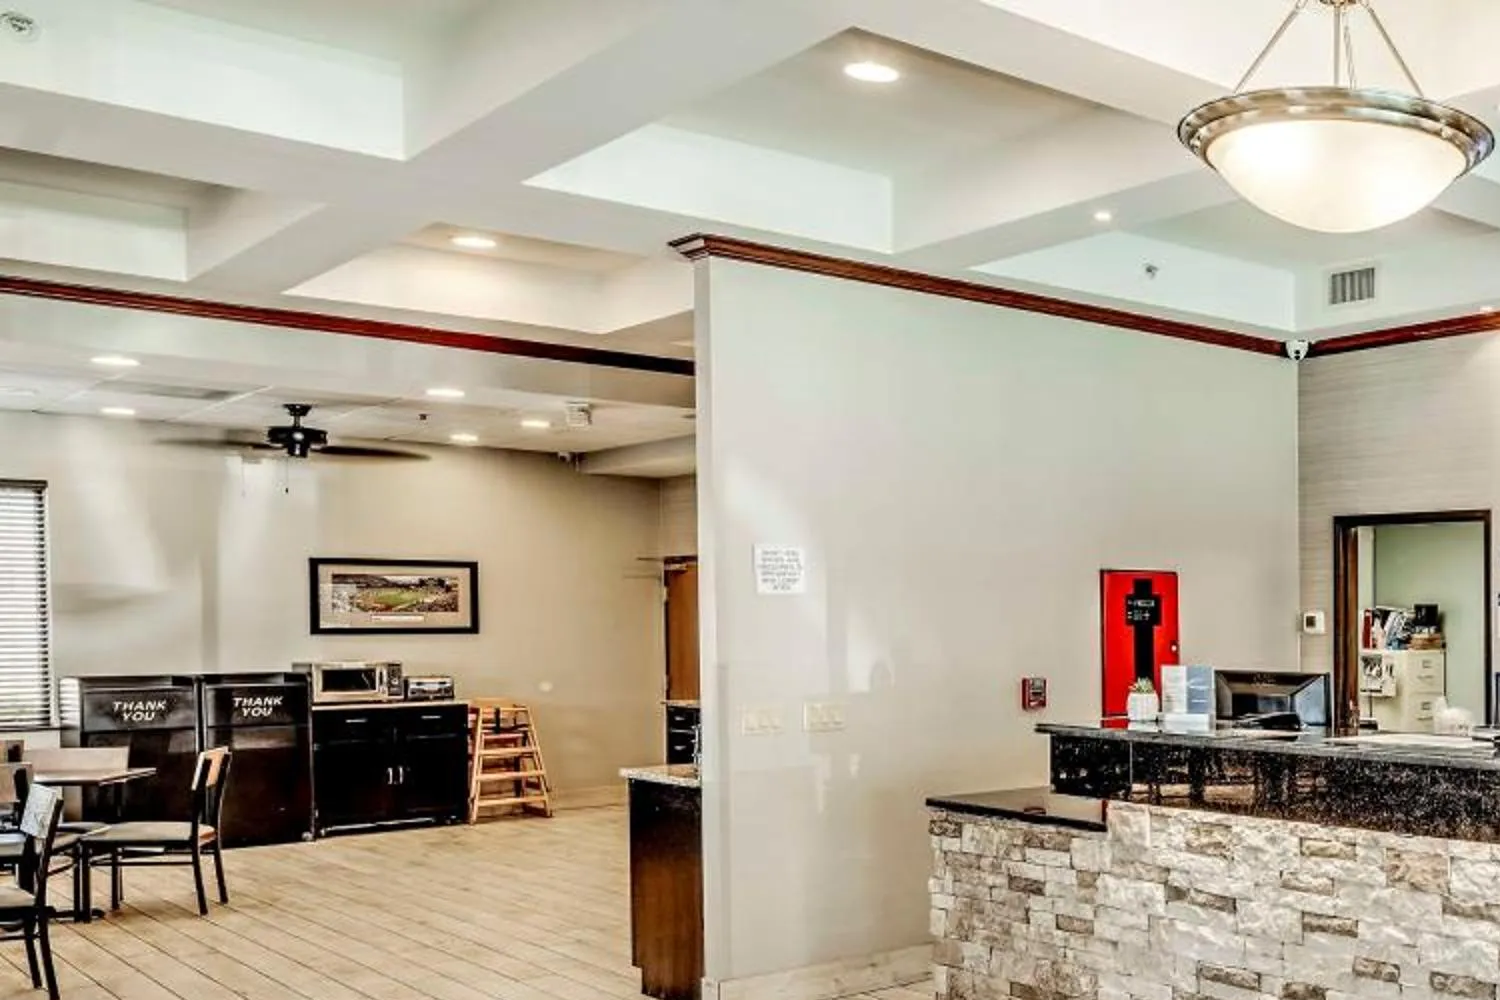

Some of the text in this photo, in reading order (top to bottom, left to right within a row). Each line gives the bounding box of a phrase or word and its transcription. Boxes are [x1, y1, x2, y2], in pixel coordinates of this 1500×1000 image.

[112, 700, 167, 712] THANK
[232, 696, 283, 707] THANK
[122, 711, 156, 721] YOU
[242, 707, 273, 717] YOU
